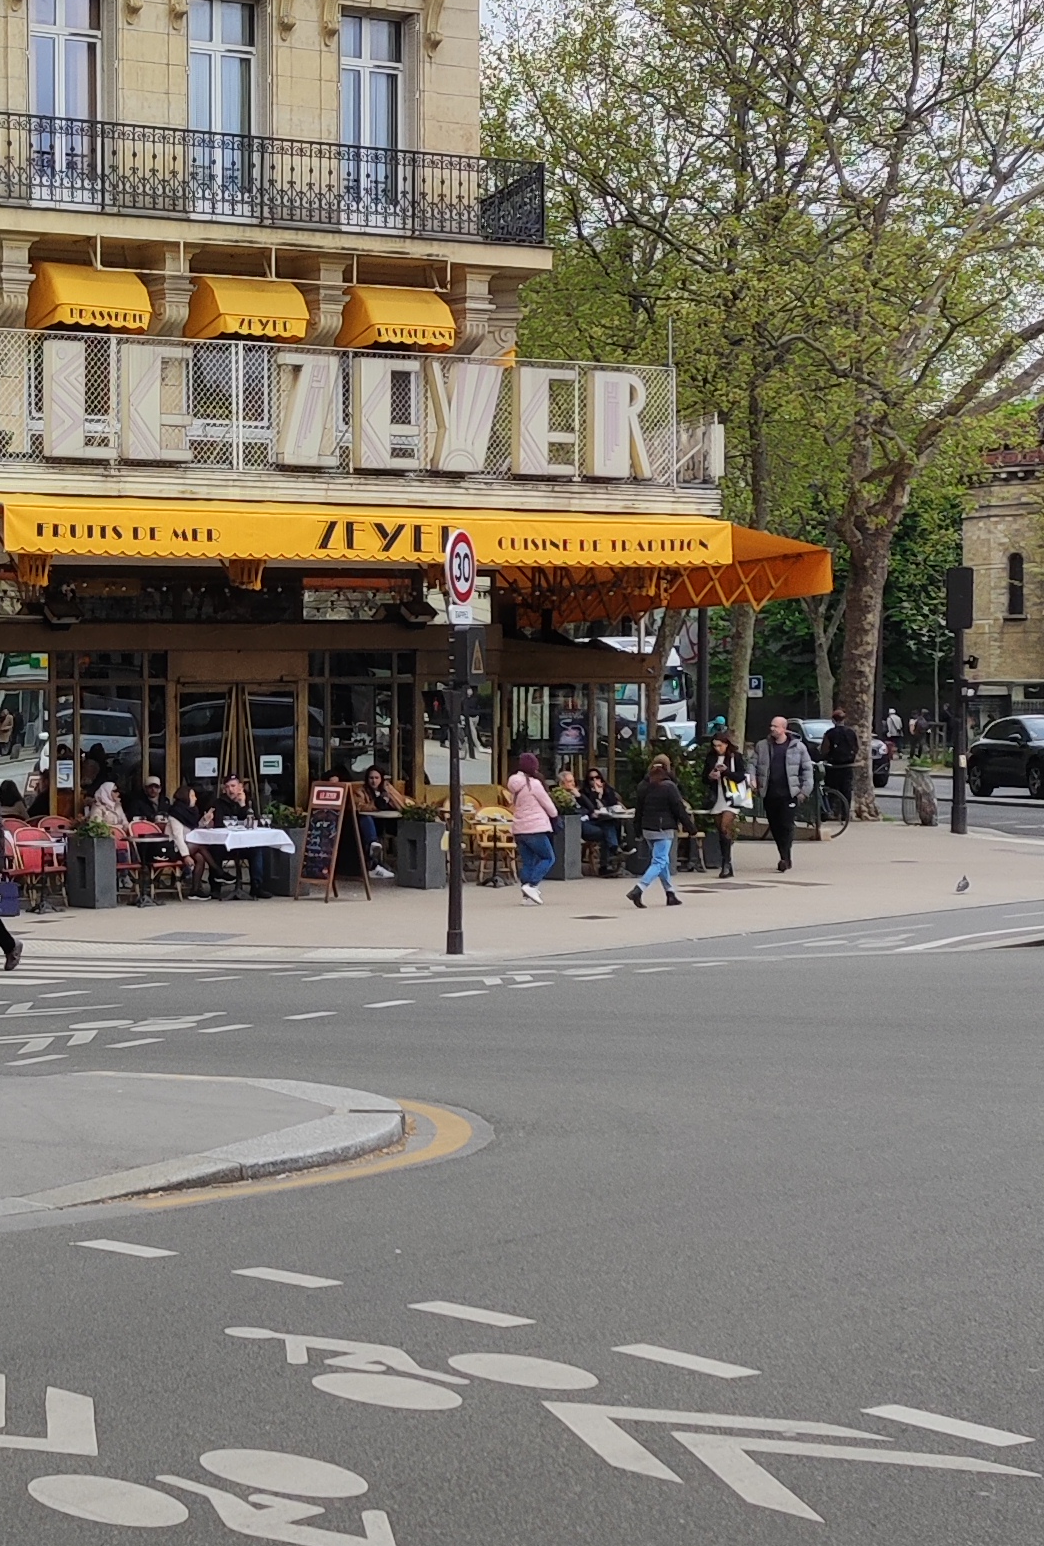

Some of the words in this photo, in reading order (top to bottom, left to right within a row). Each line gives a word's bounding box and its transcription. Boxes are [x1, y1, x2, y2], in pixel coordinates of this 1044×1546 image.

[69, 307, 146, 325] BRASSERIE
[238, 317, 294, 333] ZEYER
[43, 339, 194, 462] LE
[276, 351, 653, 480] ZEYER
[36, 522, 124, 540] FRUITS
[132, 526, 163, 541] DE
[169, 527, 222, 543] MER
[497, 535, 573, 553] CUISINE
[578, 538, 603, 552] DE
[609, 538, 710, 553] TRADITION
[454, 551, 472, 584] 30
[751, 678, 759, 689] P
